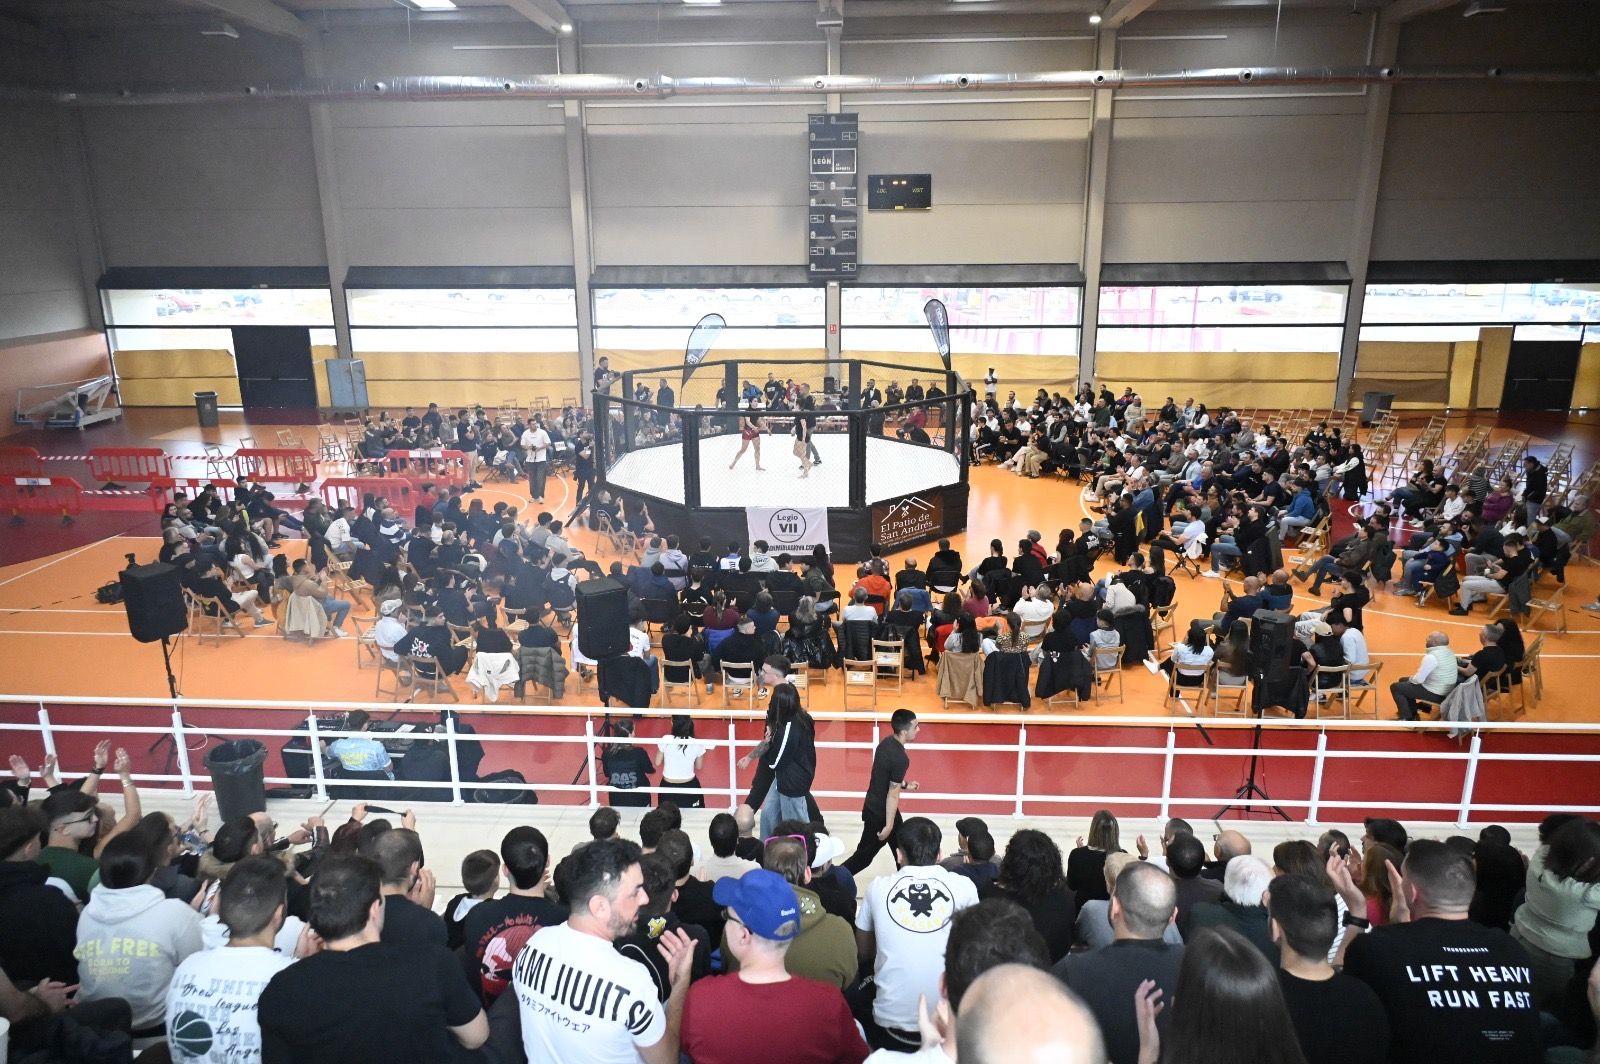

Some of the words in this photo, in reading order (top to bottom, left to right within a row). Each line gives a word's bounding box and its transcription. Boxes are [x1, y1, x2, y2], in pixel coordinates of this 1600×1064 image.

[813, 156, 831, 165] LEÓN
[776, 513, 798, 522] Legio
[881, 523, 890, 533] El
[892, 517, 917, 530] Patio
[918, 513, 930, 522] de
[779, 523, 797, 533] VII
[880, 531, 898, 541] San
[900, 520, 933, 536] Andrés
[111, 937, 161, 958] FREE
[1406, 965, 1459, 982] LIFT
[1469, 966, 1531, 984] HEAVY
[1427, 990, 1480, 1008] RUN
[1488, 990, 1531, 1008] FAST
[226, 1043, 260, 1059] Ange
